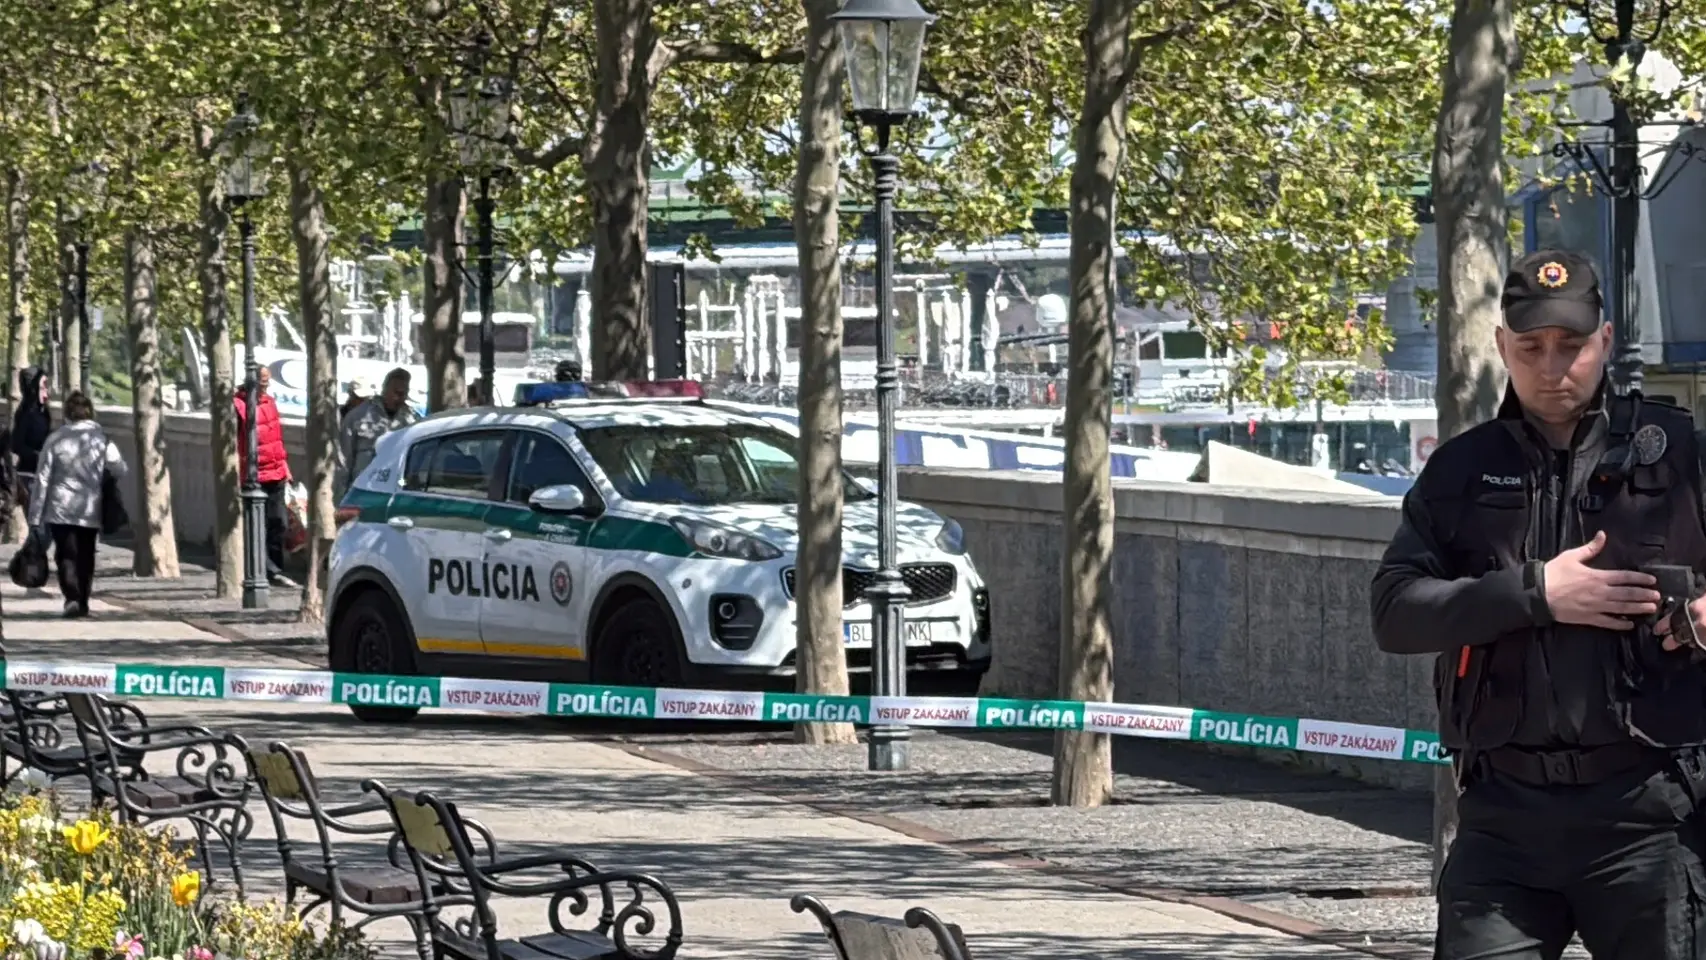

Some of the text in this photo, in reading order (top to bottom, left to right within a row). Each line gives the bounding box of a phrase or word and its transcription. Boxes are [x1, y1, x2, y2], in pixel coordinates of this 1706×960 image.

[428, 552, 540, 602] POLÍCIA
[14, 672, 48, 686] VSTUP
[124, 671, 216, 696] POLÍCIA
[231, 679, 325, 697] VSTUP ZAKÁZANÝ
[342, 680, 432, 705] POLÍCIA
[446, 690, 541, 708] VSTUP ZAKÁZANÝ
[557, 691, 648, 716] POLÍCIA
[662, 699, 756, 716] VSTUP ZAKÁZANÝ
[772, 699, 861, 722] POLÍCIA
[876, 708, 910, 720] VSTUP
[985, 703, 1076, 729] POLÍCIA
[1091, 714, 1125, 727] VSTUP
[1200, 718, 1289, 746] POLÍCIA
[1304, 730, 1339, 747] VSTUP
[1340, 732, 1397, 753] ZAKÁZANÝ
